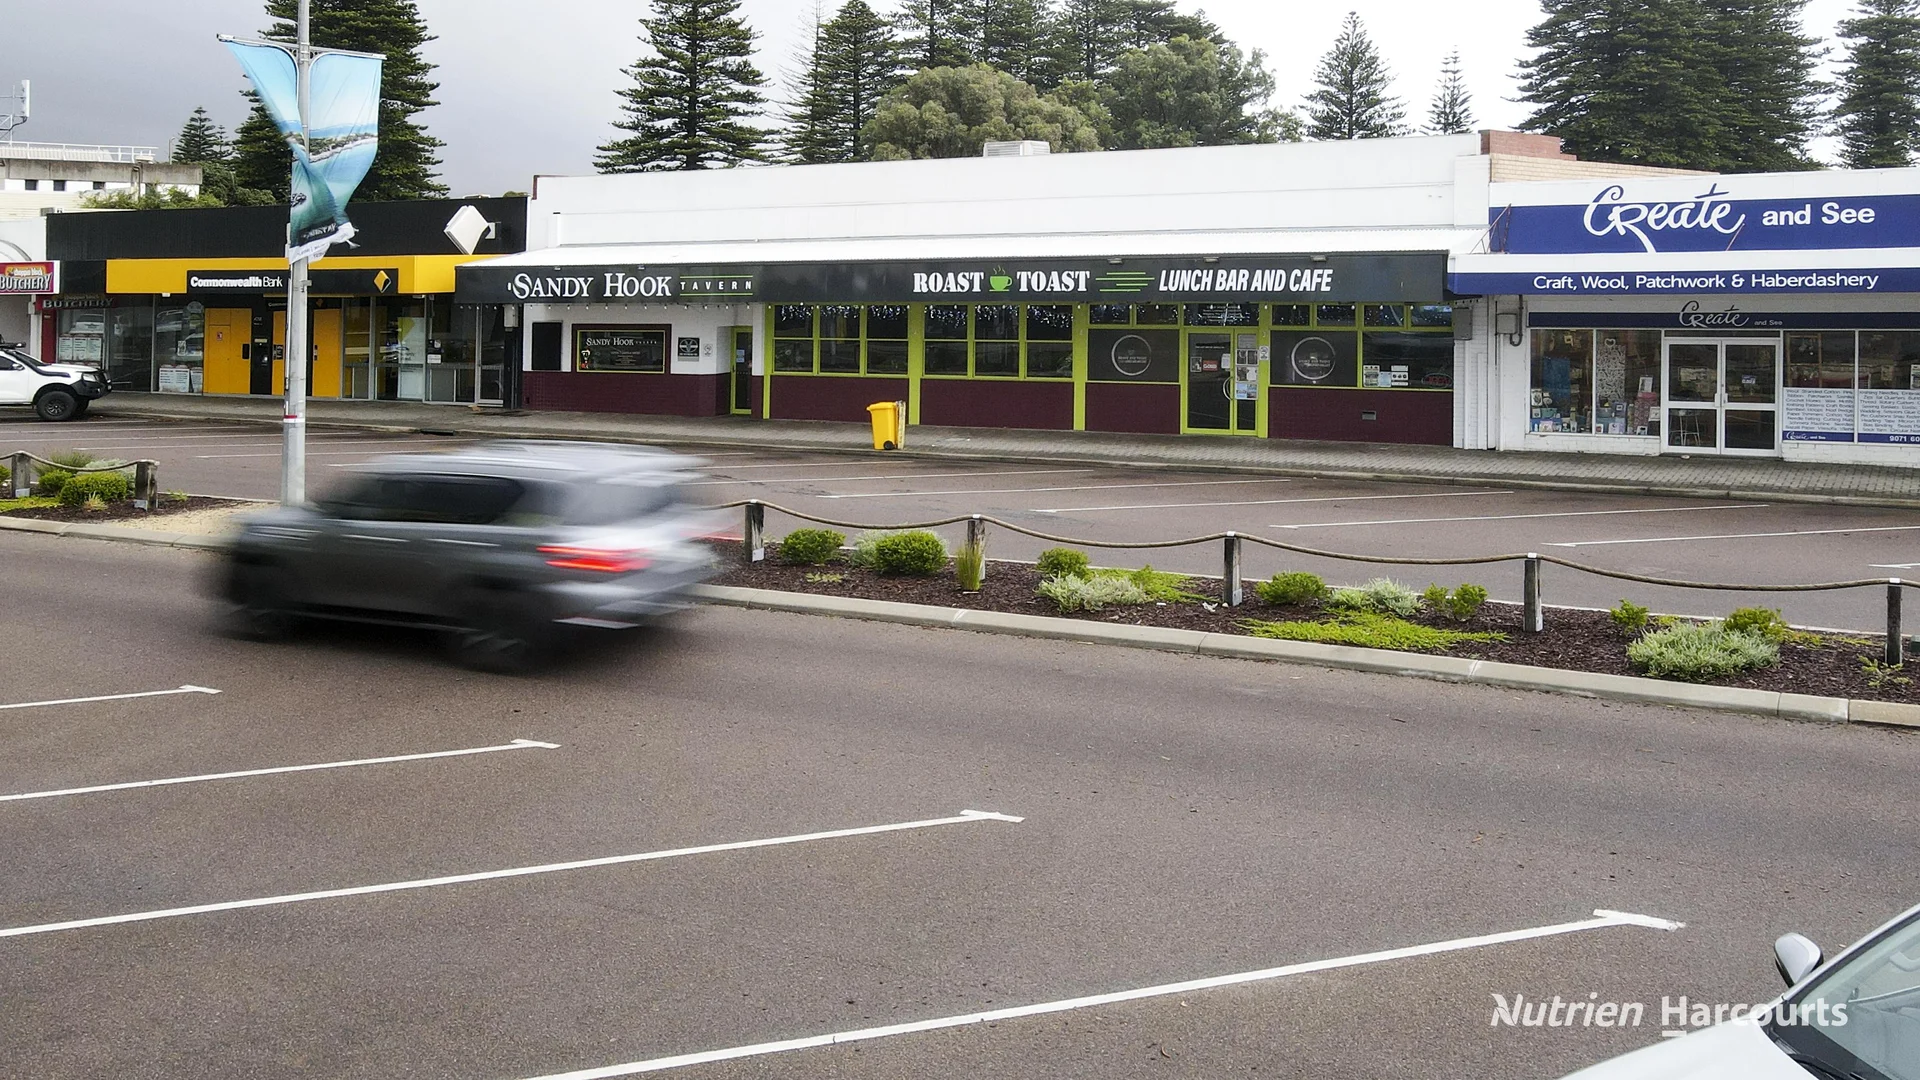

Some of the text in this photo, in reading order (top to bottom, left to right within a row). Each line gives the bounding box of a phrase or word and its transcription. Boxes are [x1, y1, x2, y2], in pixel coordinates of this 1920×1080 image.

[1762, 203, 1811, 226] and
[1821, 202, 1876, 225] See
[0, 272, 52, 291] BUTCHERY
[190, 275, 283, 288] Commonwealth Bank
[508, 272, 752, 299] SANDY HOOK TAVERN
[913, 270, 1090, 293] ROAST TOAST
[1158, 269, 1334, 292] LUNCH BAR AND CAFE
[1533, 272, 1880, 291] Craft, Wool, Patchwork & Haberdashery
[586, 337, 611, 346] SANDY
[613, 337, 634, 346] HOOK
